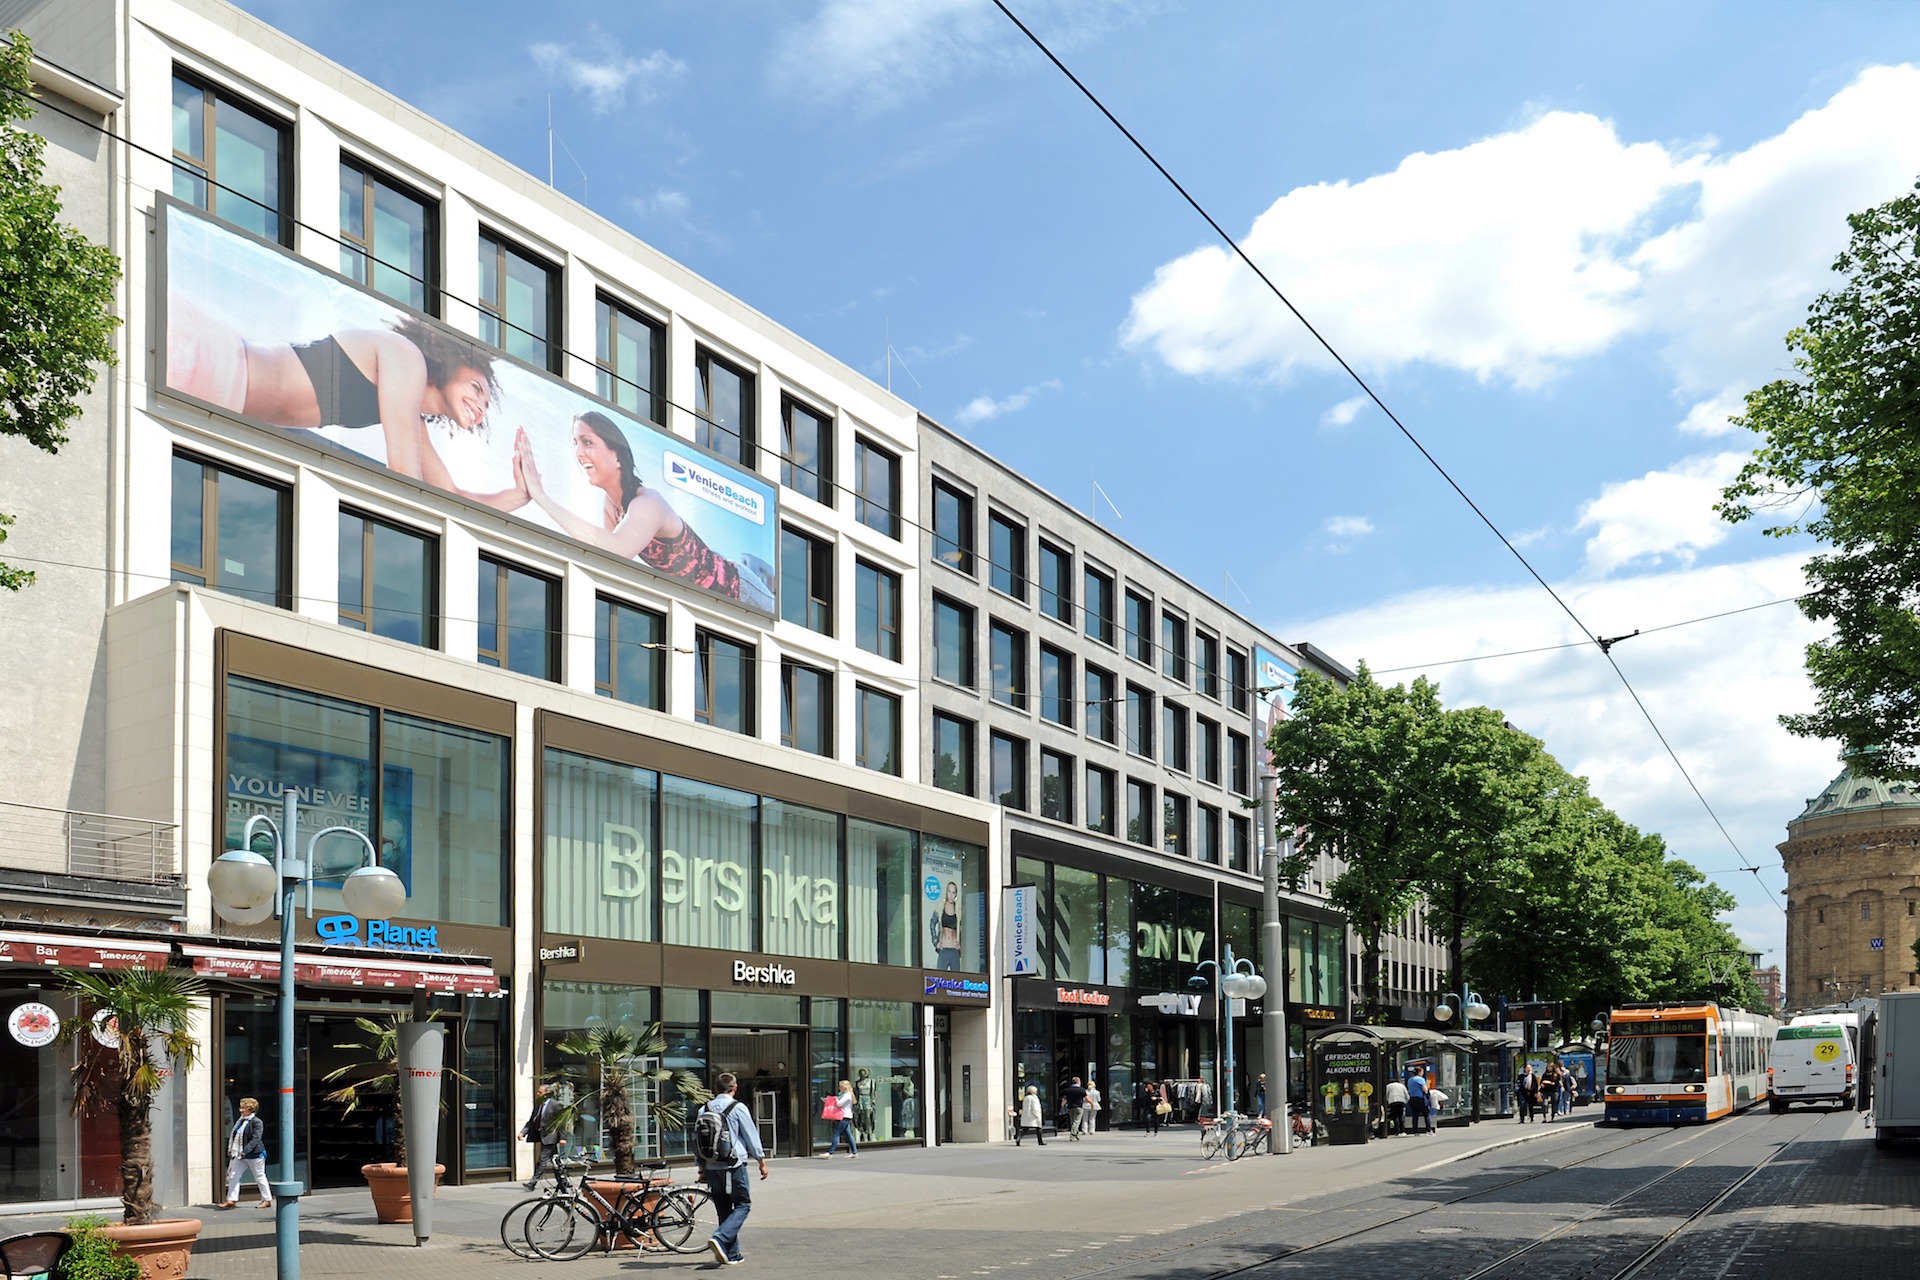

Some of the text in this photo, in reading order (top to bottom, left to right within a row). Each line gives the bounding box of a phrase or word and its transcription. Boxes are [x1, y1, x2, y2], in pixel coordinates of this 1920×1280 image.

[688, 468, 758, 509] VeniceBeach
[734, 502, 758, 517] workout
[229, 773, 284, 798] YOU
[1014, 889, 1023, 958] VeniceBeach
[367, 919, 438, 947] Planet
[36, 945, 59, 956] Bar
[1137, 920, 1206, 964] ONLY
[540, 945, 578, 960] Bershka
[734, 960, 796, 985] Bershka
[936, 976, 989, 993] VeniceBeach
[1079, 988, 1110, 1006] Locker
[1158, 992, 1202, 1016] ONLY
[1642, 1023, 1694, 1032] Sandhofen
[1324, 1052, 1371, 1061] ERFRISCHEND.
[1821, 1044, 1835, 1054] 29
[1325, 1066, 1372, 1074] ALKOHOLFREI.
